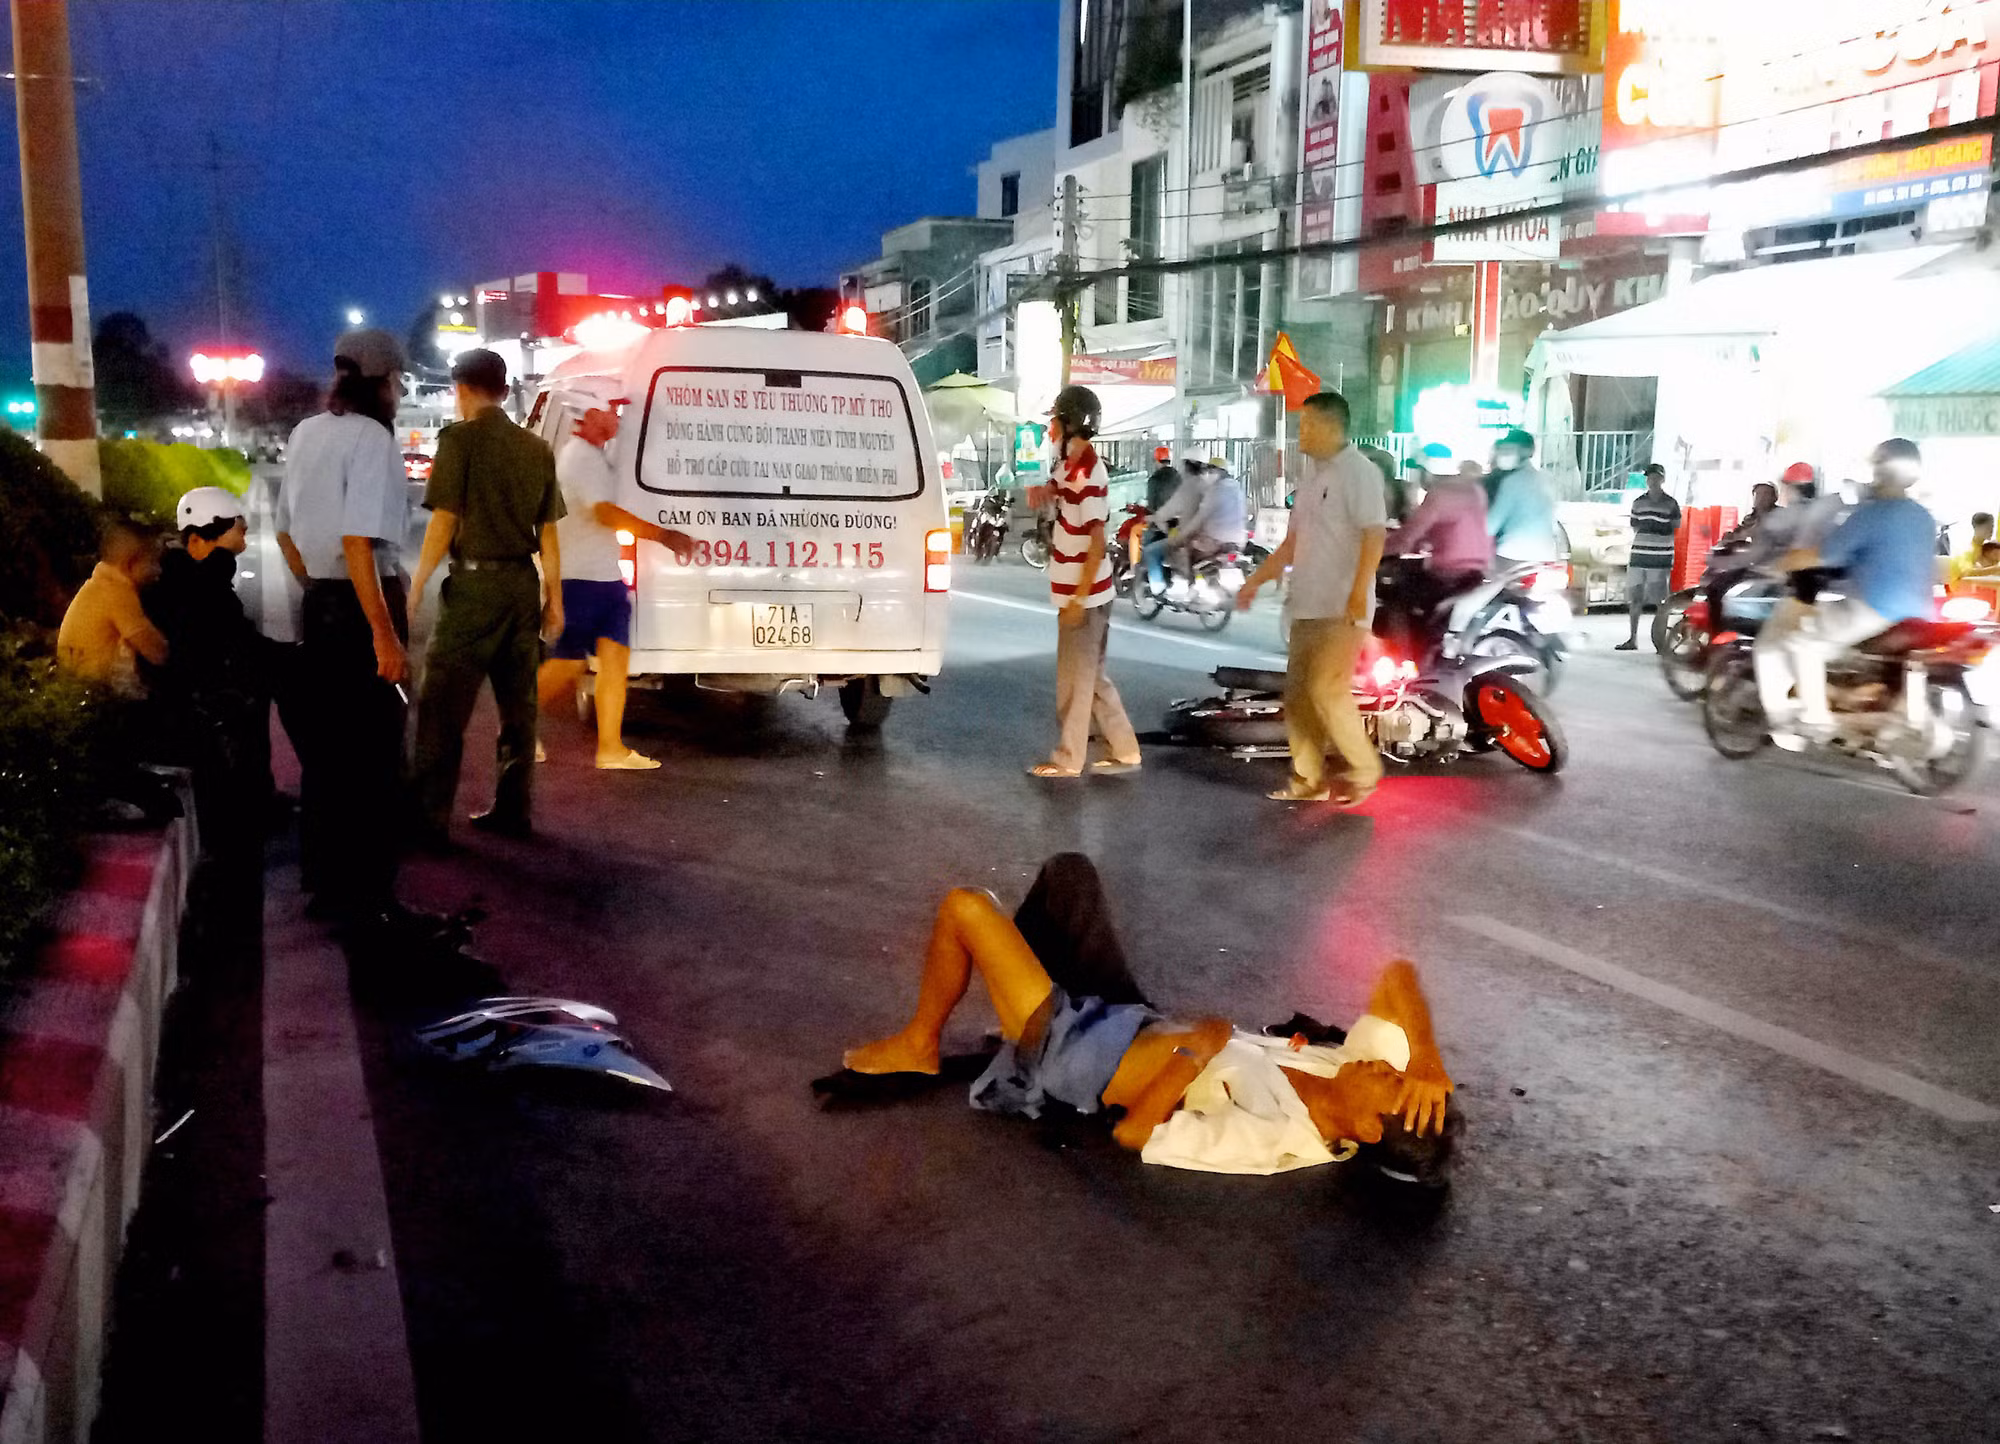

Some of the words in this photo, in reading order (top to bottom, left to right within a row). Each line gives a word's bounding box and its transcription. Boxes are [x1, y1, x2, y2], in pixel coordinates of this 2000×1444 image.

[666, 384, 703, 407] NHÓM
[752, 386, 777, 410] YÊU
[781, 391, 828, 414] THƯƠNG
[870, 399, 893, 418] THO
[697, 419, 724, 441] HÀNH
[775, 427, 808, 446] THANH
[707, 452, 728, 476] CẤP
[795, 463, 818, 480] GIAO
[768, 605, 798, 624] 71A
